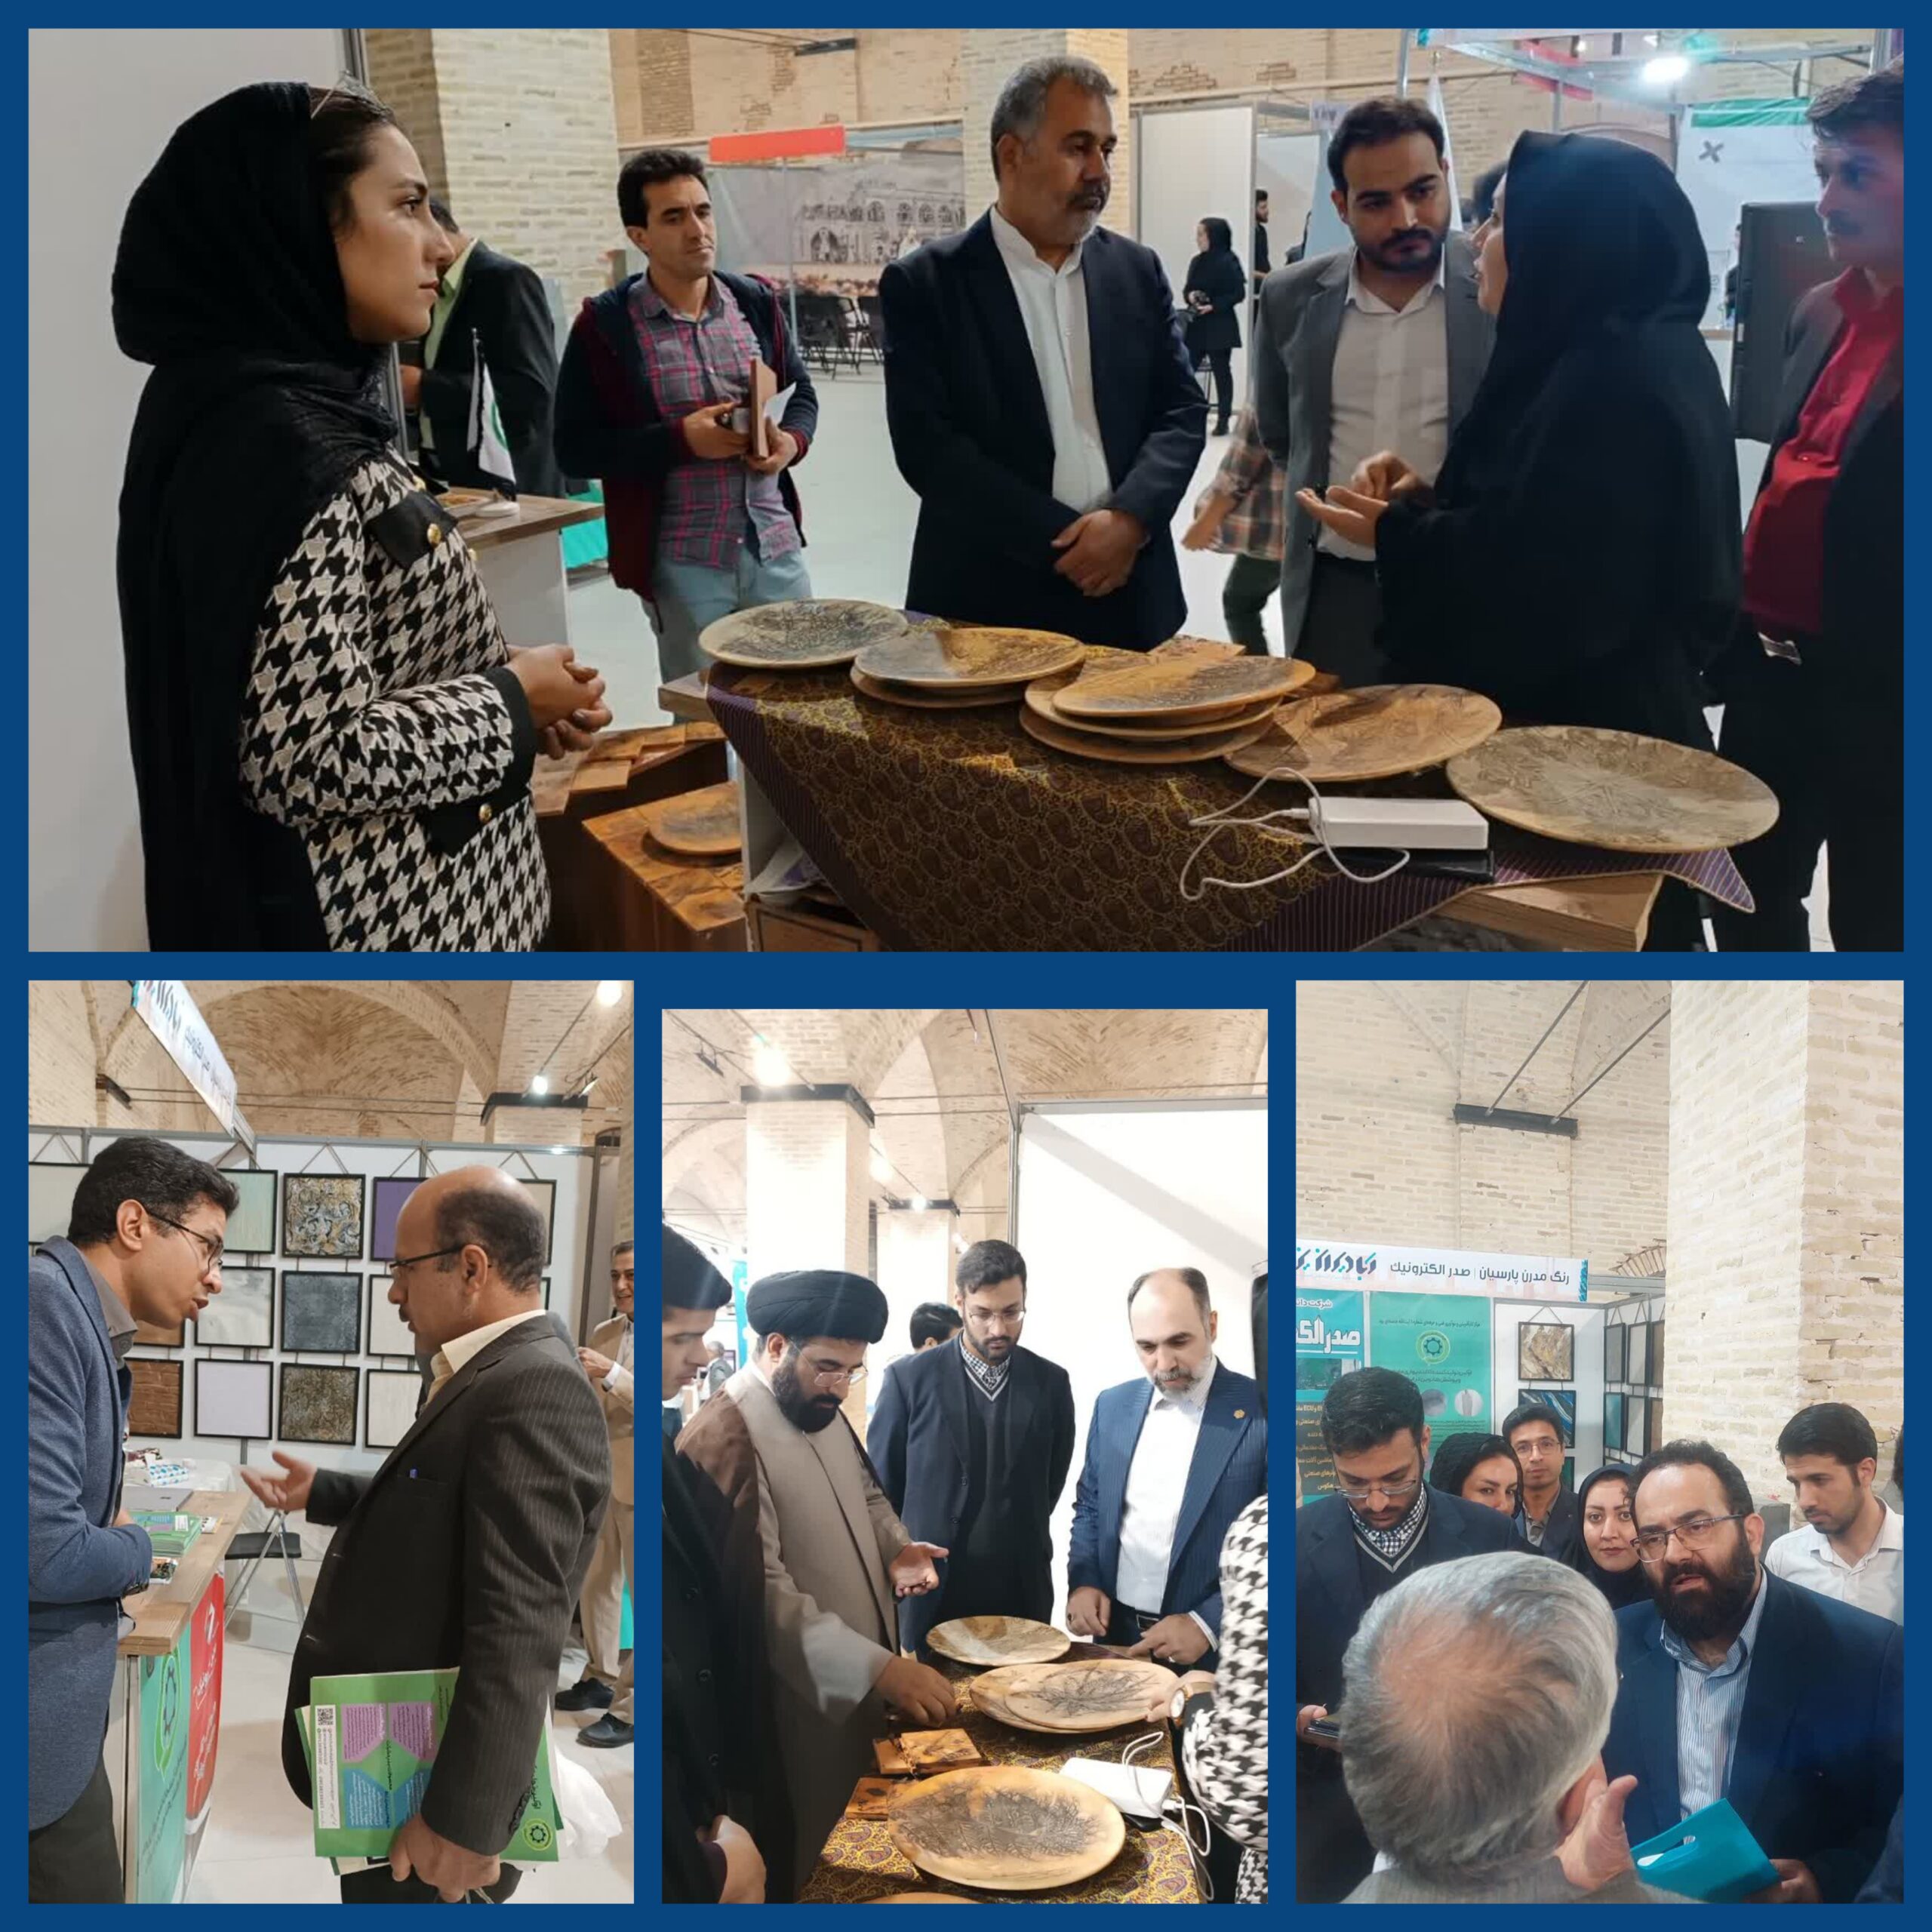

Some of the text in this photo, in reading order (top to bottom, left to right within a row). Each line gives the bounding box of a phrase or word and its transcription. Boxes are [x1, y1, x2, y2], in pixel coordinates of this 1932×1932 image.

[1448, 1266, 1471, 1278] صدر
[1479, 1266, 1519, 1284] پارسیان
[1521, 1270, 1547, 1283] مدرن
[1550, 1270, 1570, 1285] رنگ
[1296, 1298, 1333, 1309] شرکت دان
[1324, 1330, 1361, 1354] صدر
